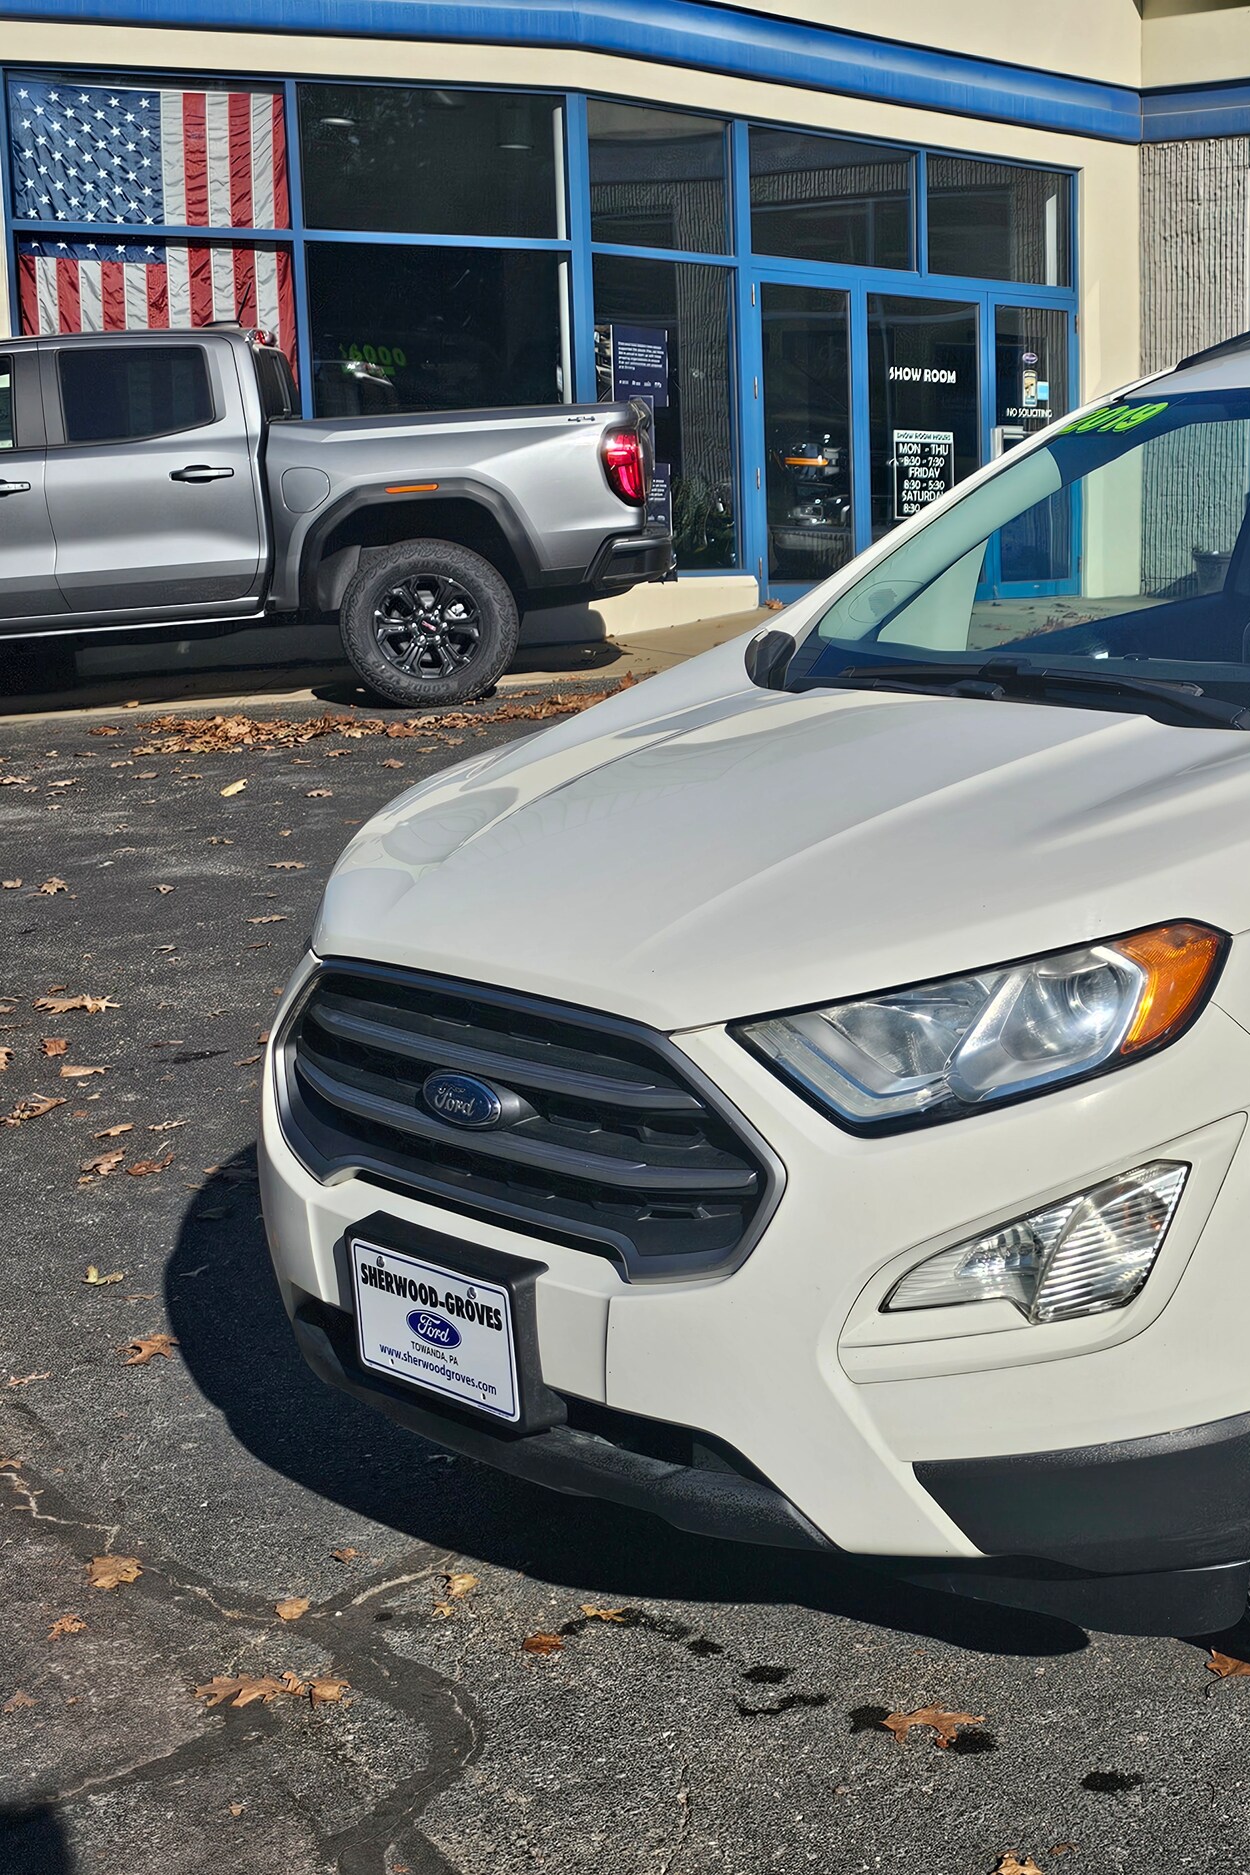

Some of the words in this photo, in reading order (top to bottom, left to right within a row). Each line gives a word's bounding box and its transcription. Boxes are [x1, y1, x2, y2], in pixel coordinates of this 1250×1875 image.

[889, 366, 922, 382] SHOW
[923, 368, 957, 384] ROOM
[1006, 407, 1017, 418] NO
[899, 443, 921, 454] MON
[930, 444, 949, 456] THU
[928, 457, 945, 468] 7:30
[908, 467, 940, 478] FRIDAY
[928, 480, 945, 491] 5:30
[902, 490, 944, 502] SATURDA
[434, 1083, 476, 1117] Ford
[360, 1262, 503, 1332] SHERWOOD-GROVES
[417, 1313, 451, 1343] Ford
[410, 1340, 449, 1363] TOWANDA,
[449, 1354, 460, 1367] PA
[379, 1343, 497, 1396] www.sherwoodgroves.com
